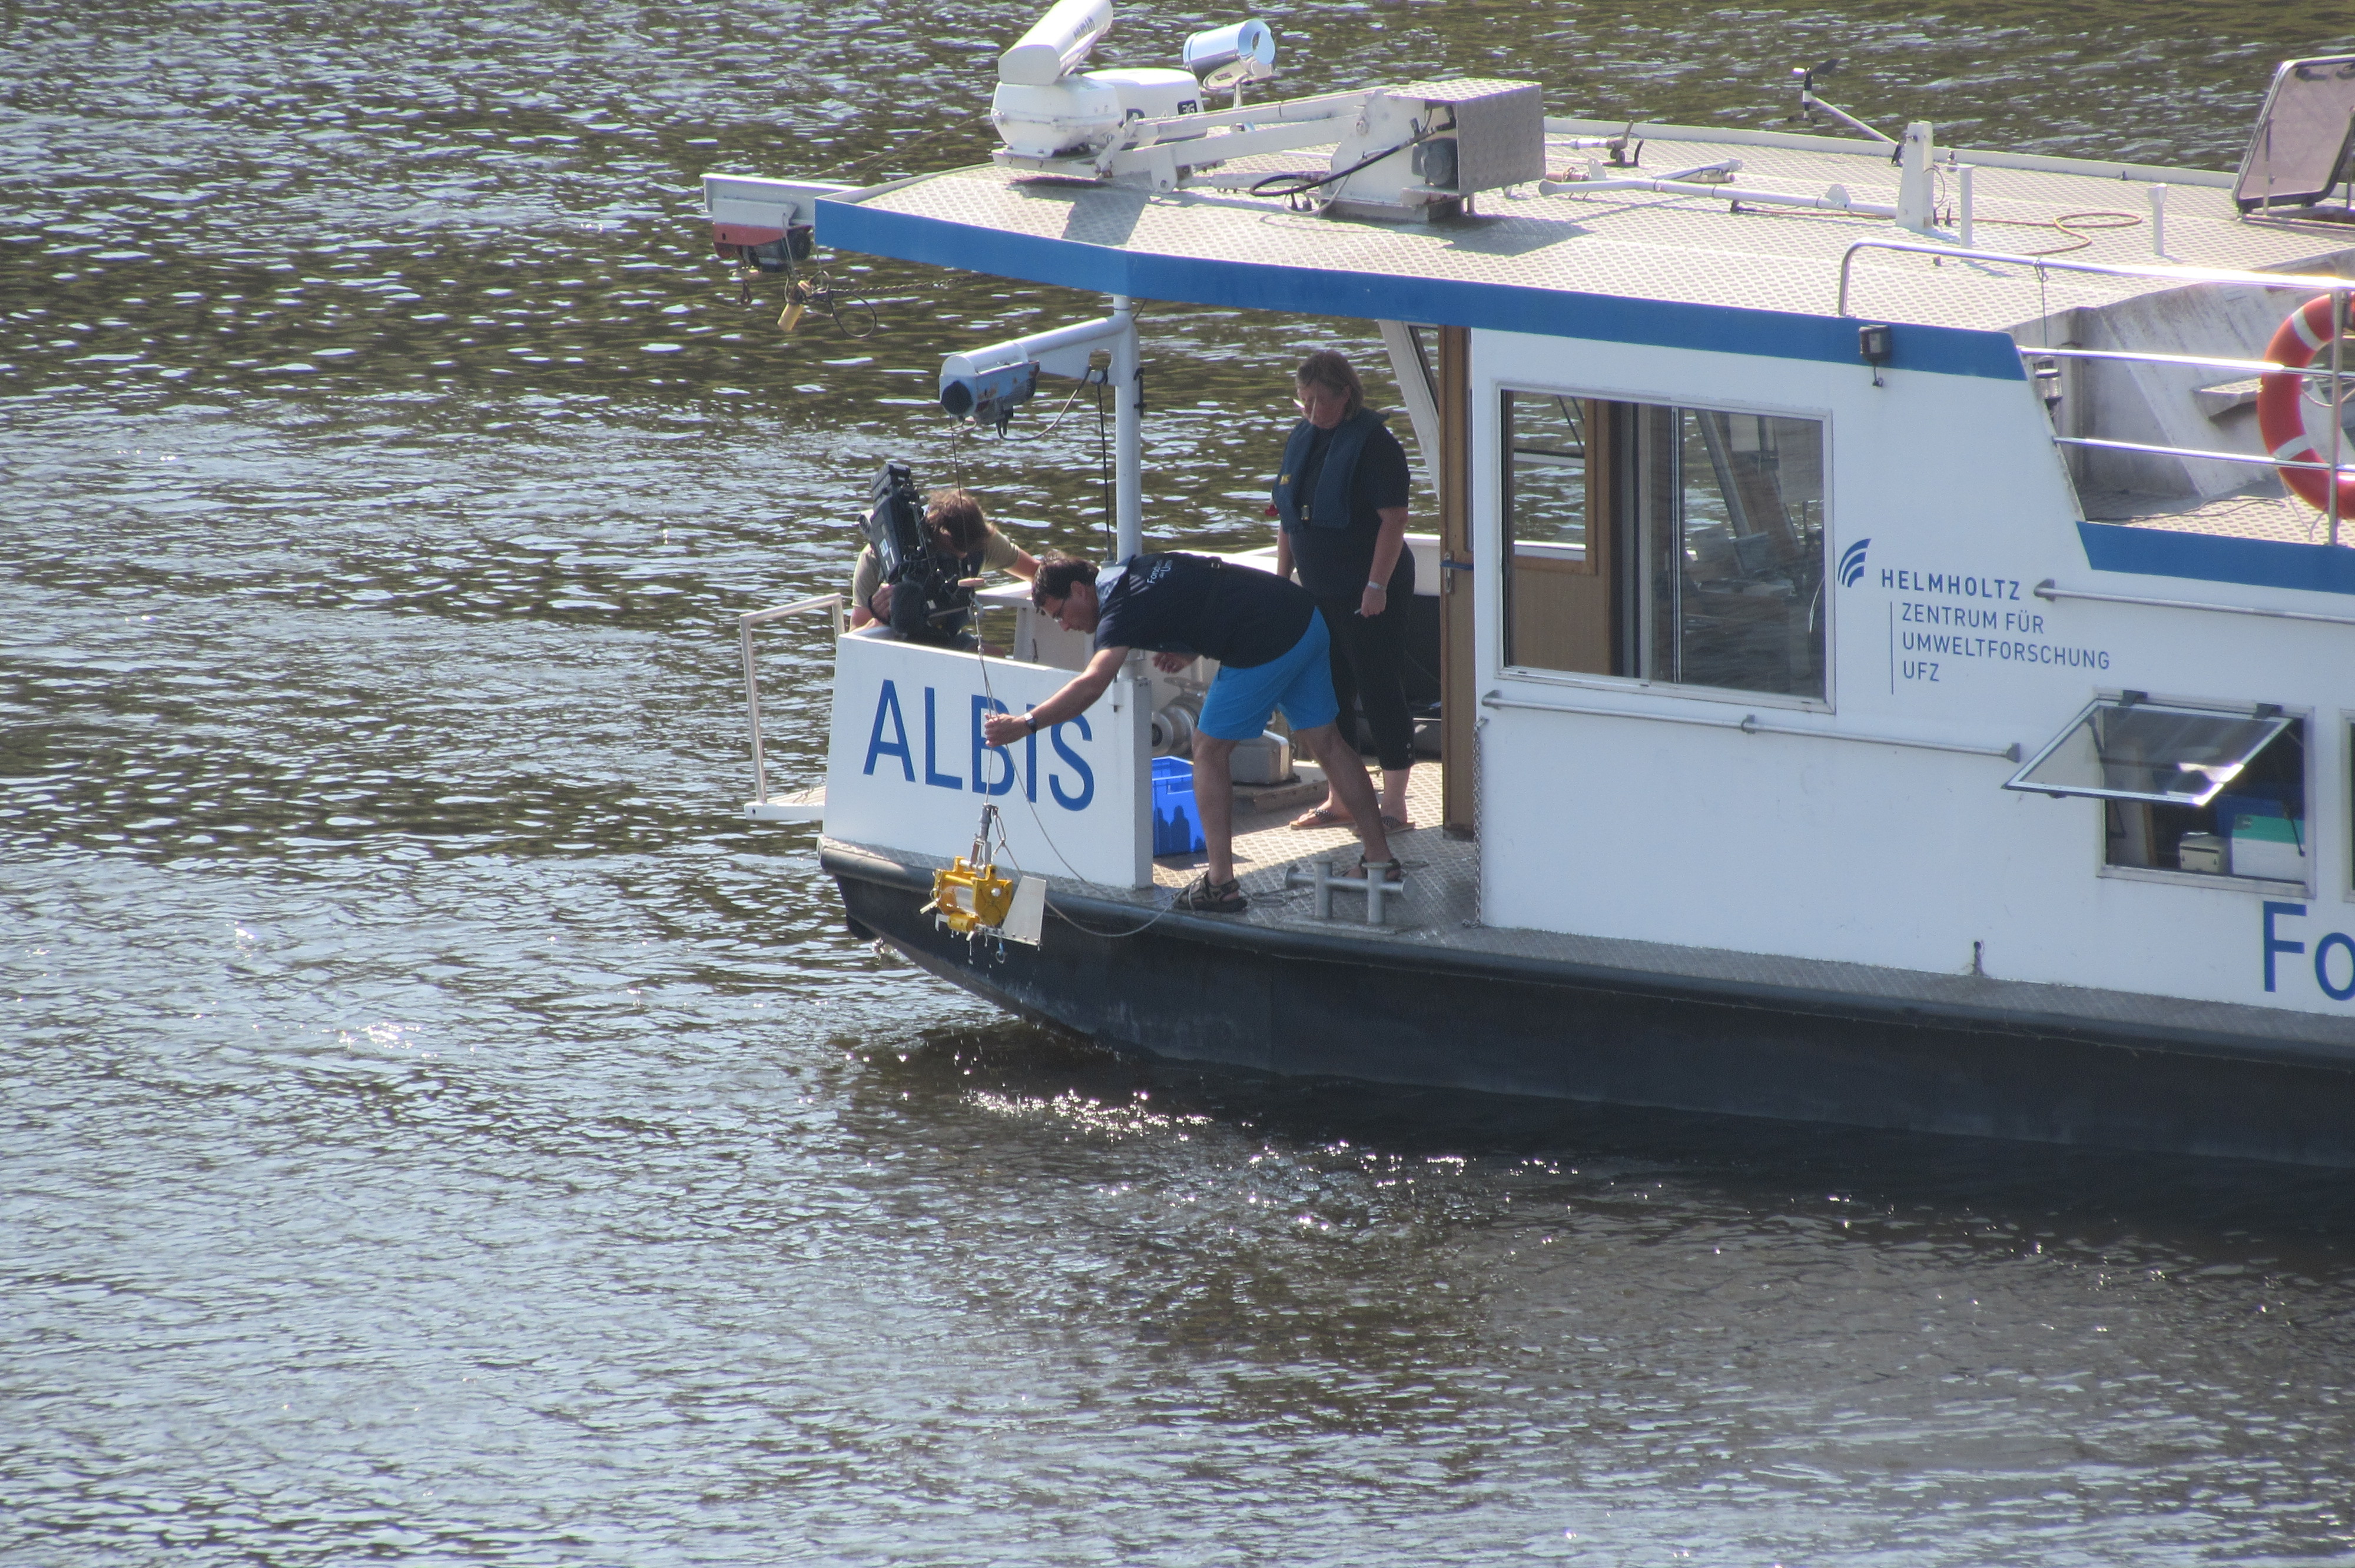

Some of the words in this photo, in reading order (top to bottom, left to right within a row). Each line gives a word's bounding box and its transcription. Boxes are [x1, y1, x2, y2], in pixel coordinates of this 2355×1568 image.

[1881, 569, 2021, 600] HELMHOLTZ
[1902, 602, 1998, 630] ZENTRUM
[2005, 609, 2044, 634] FÜR
[1902, 632, 2111, 670] UMWELTFORSCHUNG
[1902, 660, 1939, 682] UFZ
[863, 679, 1095, 812] ALBIS
[2262, 900, 2355, 1001] Fo
